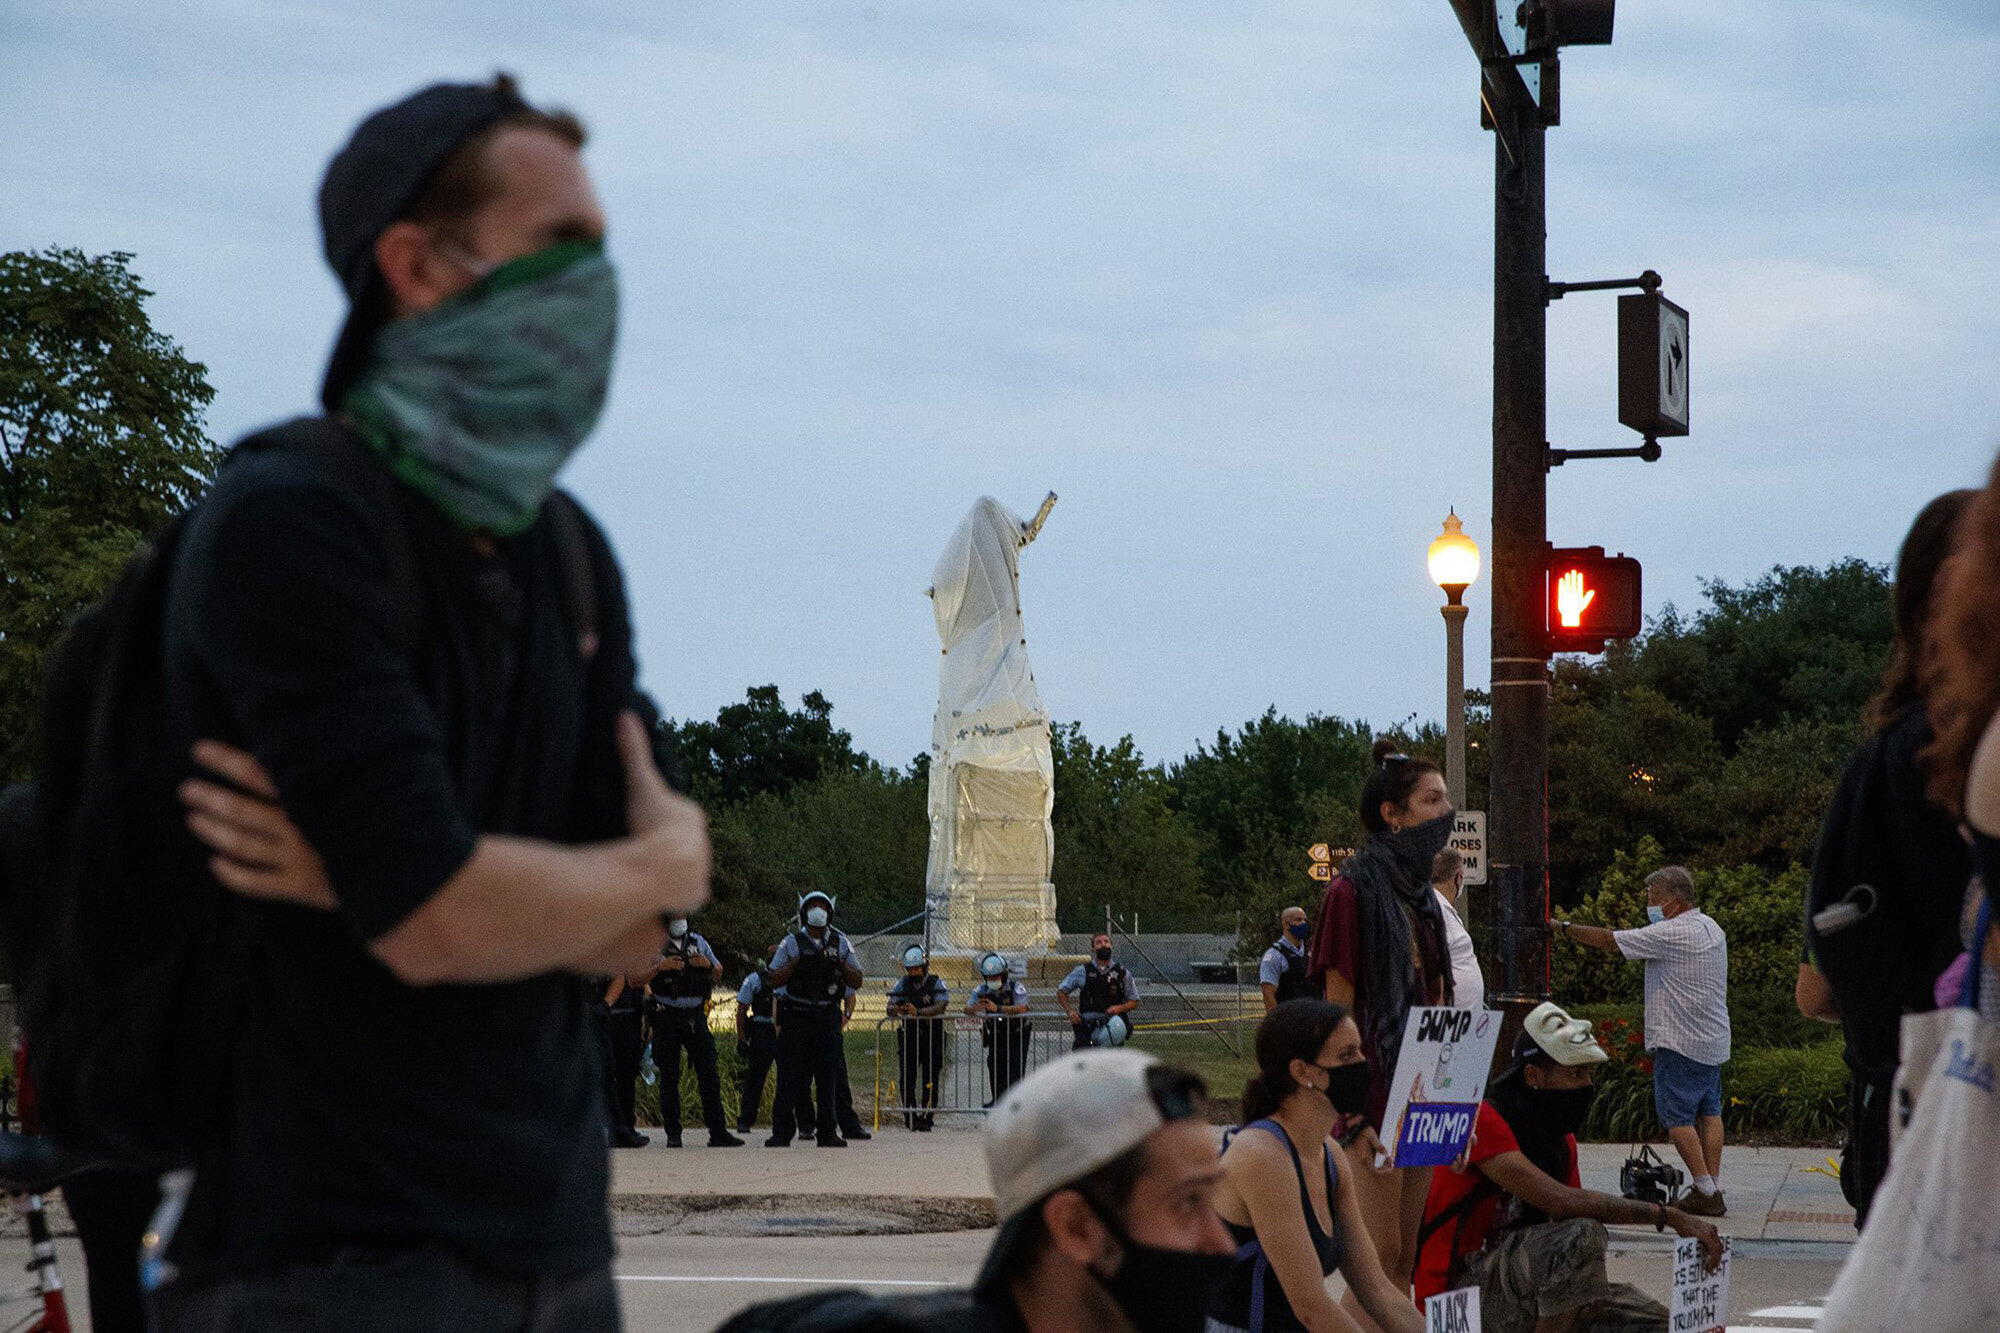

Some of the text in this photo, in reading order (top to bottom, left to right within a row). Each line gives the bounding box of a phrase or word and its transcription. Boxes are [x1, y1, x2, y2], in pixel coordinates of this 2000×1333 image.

[1453, 821, 1477, 833] RK
[1450, 838, 1482, 851] OSES
[1416, 1009, 1472, 1043] DUMP
[1406, 1111, 1470, 1145] TRUMP
[1677, 1242, 1693, 1265] THE
[1674, 1266, 1686, 1286] IS
[1682, 1284, 1719, 1307] THAT THE
[1432, 1290, 1470, 1333] BLACK
[1673, 1304, 1715, 1332] TRIUMPH
